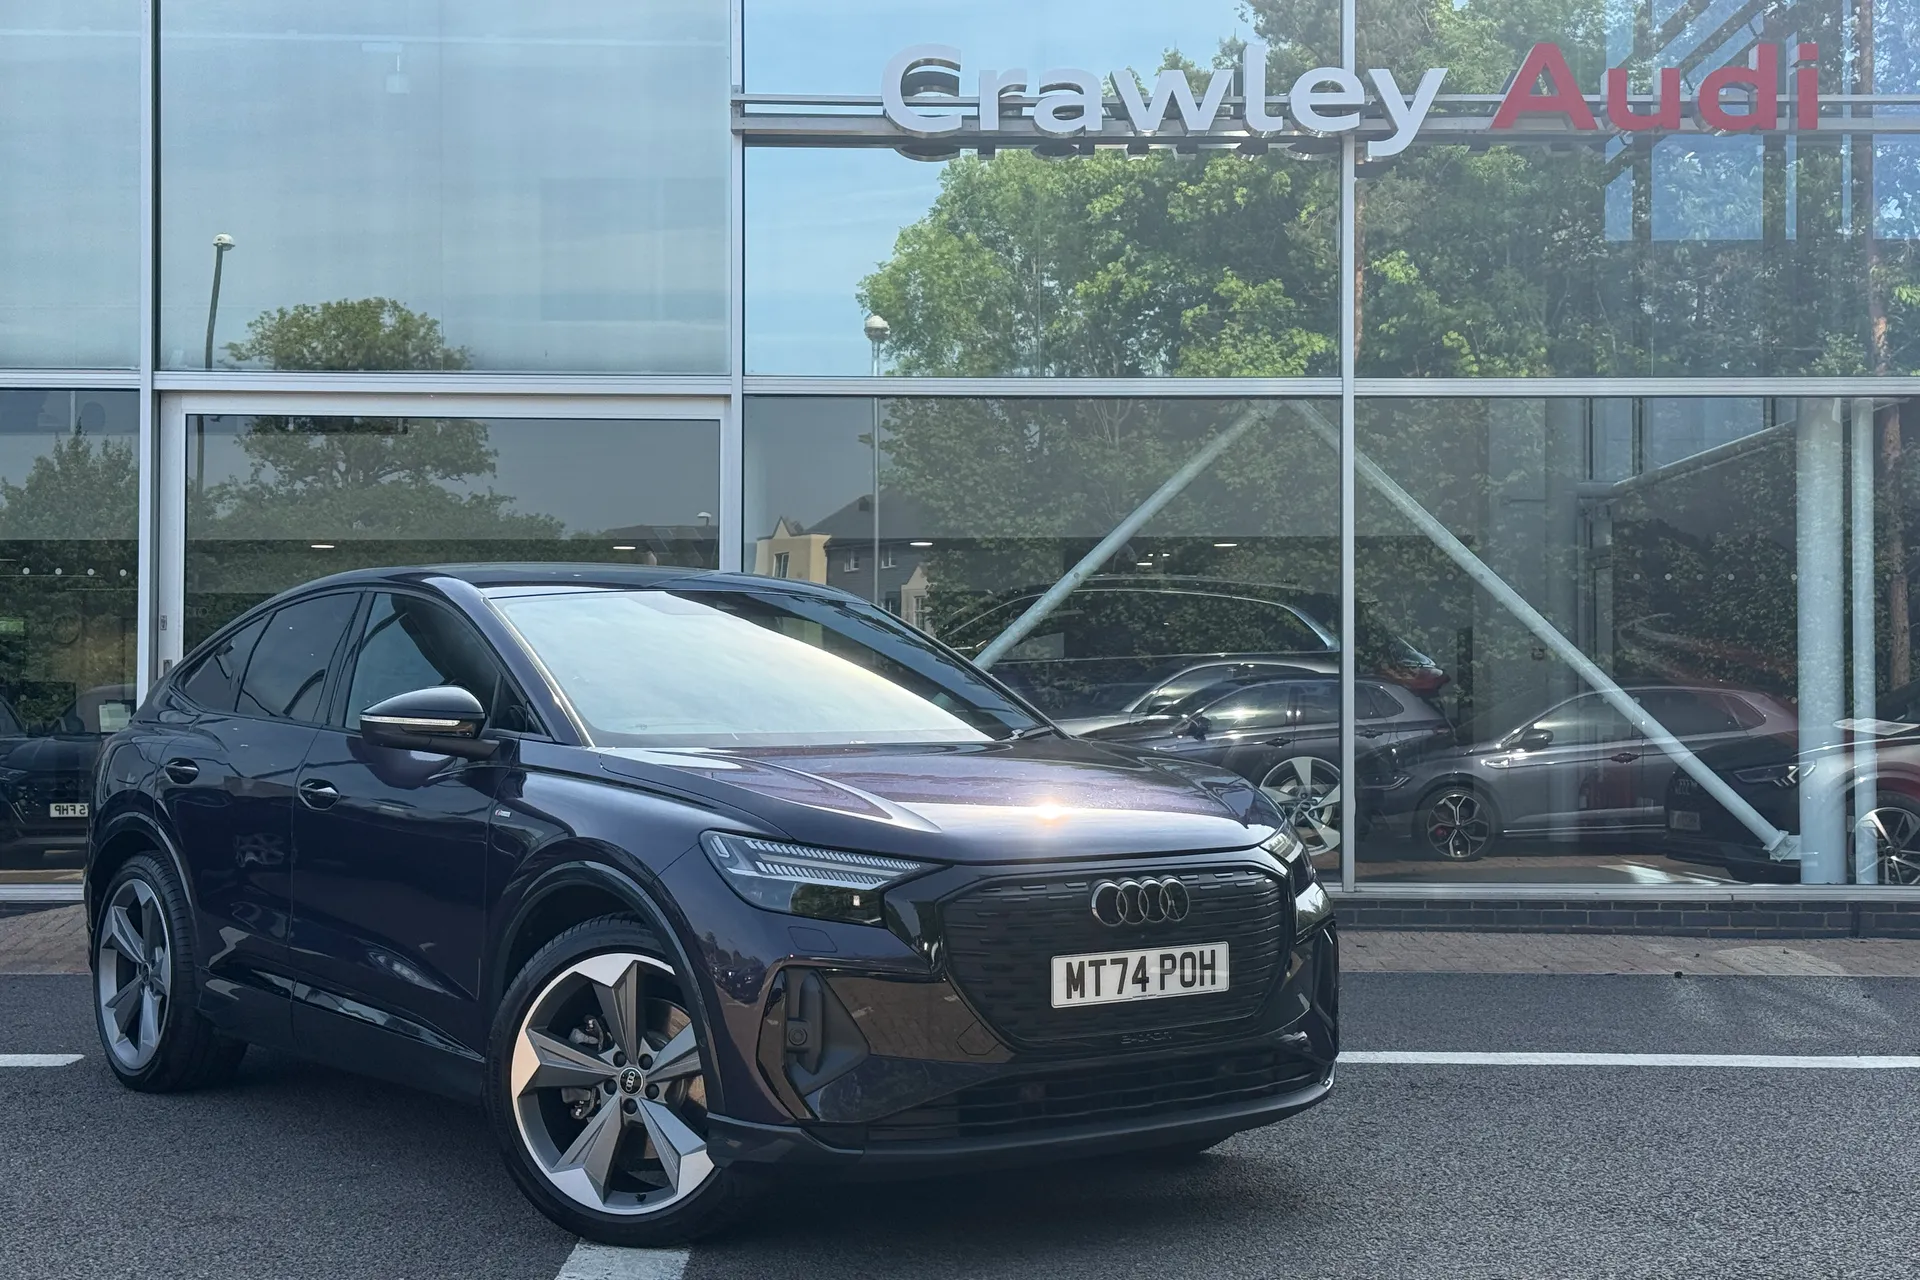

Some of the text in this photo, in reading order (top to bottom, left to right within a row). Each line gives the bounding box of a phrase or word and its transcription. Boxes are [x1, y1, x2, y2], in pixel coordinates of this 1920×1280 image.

[880, 43, 1819, 157] Crawley Audi
[1066, 949, 1216, 1000] MT74 POH
